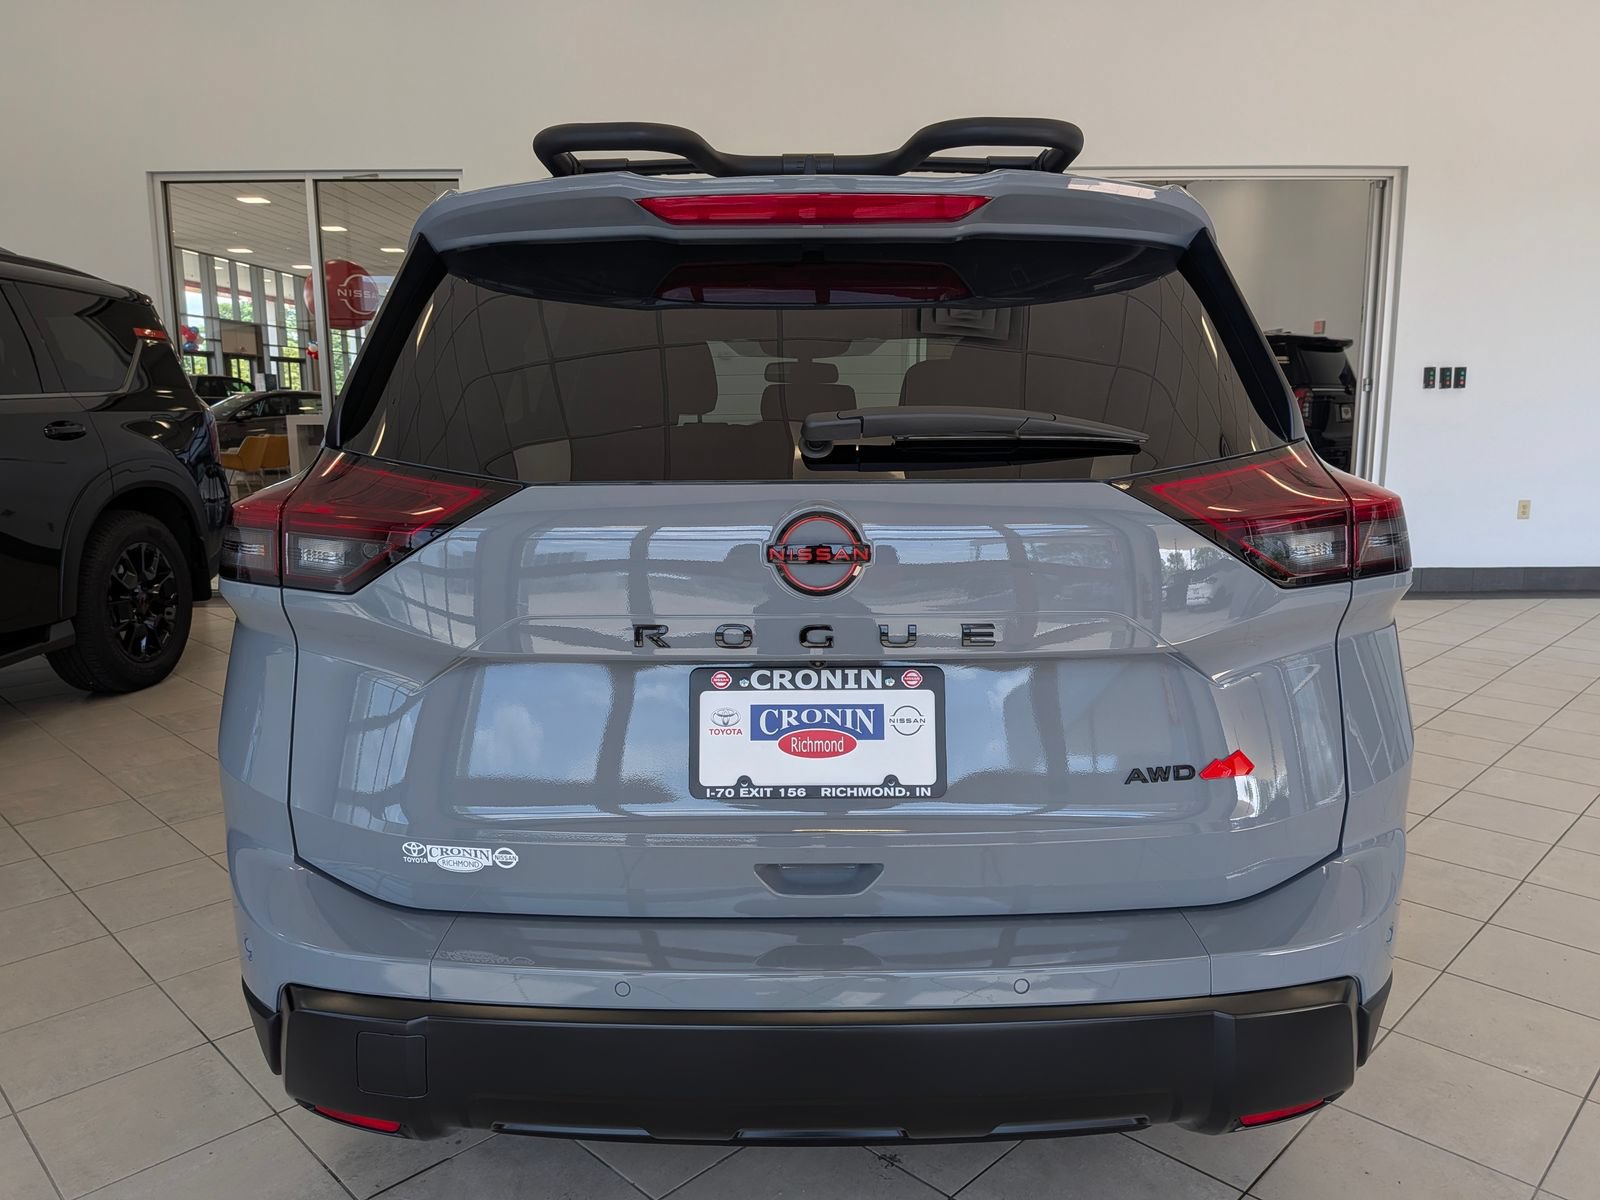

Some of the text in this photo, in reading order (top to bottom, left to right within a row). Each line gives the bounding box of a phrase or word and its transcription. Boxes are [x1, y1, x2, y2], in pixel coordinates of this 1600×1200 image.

[769, 547, 870, 562] NISSAN
[633, 624, 996, 648] ROGUE
[750, 669, 882, 690] CRONIN
[760, 708, 875, 735] CRONIN
[791, 736, 844, 753] Richmond
[1124, 764, 1196, 785] AWD
[706, 786, 931, 798] I-70 EXIT 156 RICHMOND, IN
[403, 856, 428, 864] TOYOTA
[429, 846, 490, 861] CRONIN
[494, 854, 517, 862] NISSAN
[442, 859, 480, 868] RICHMOND
